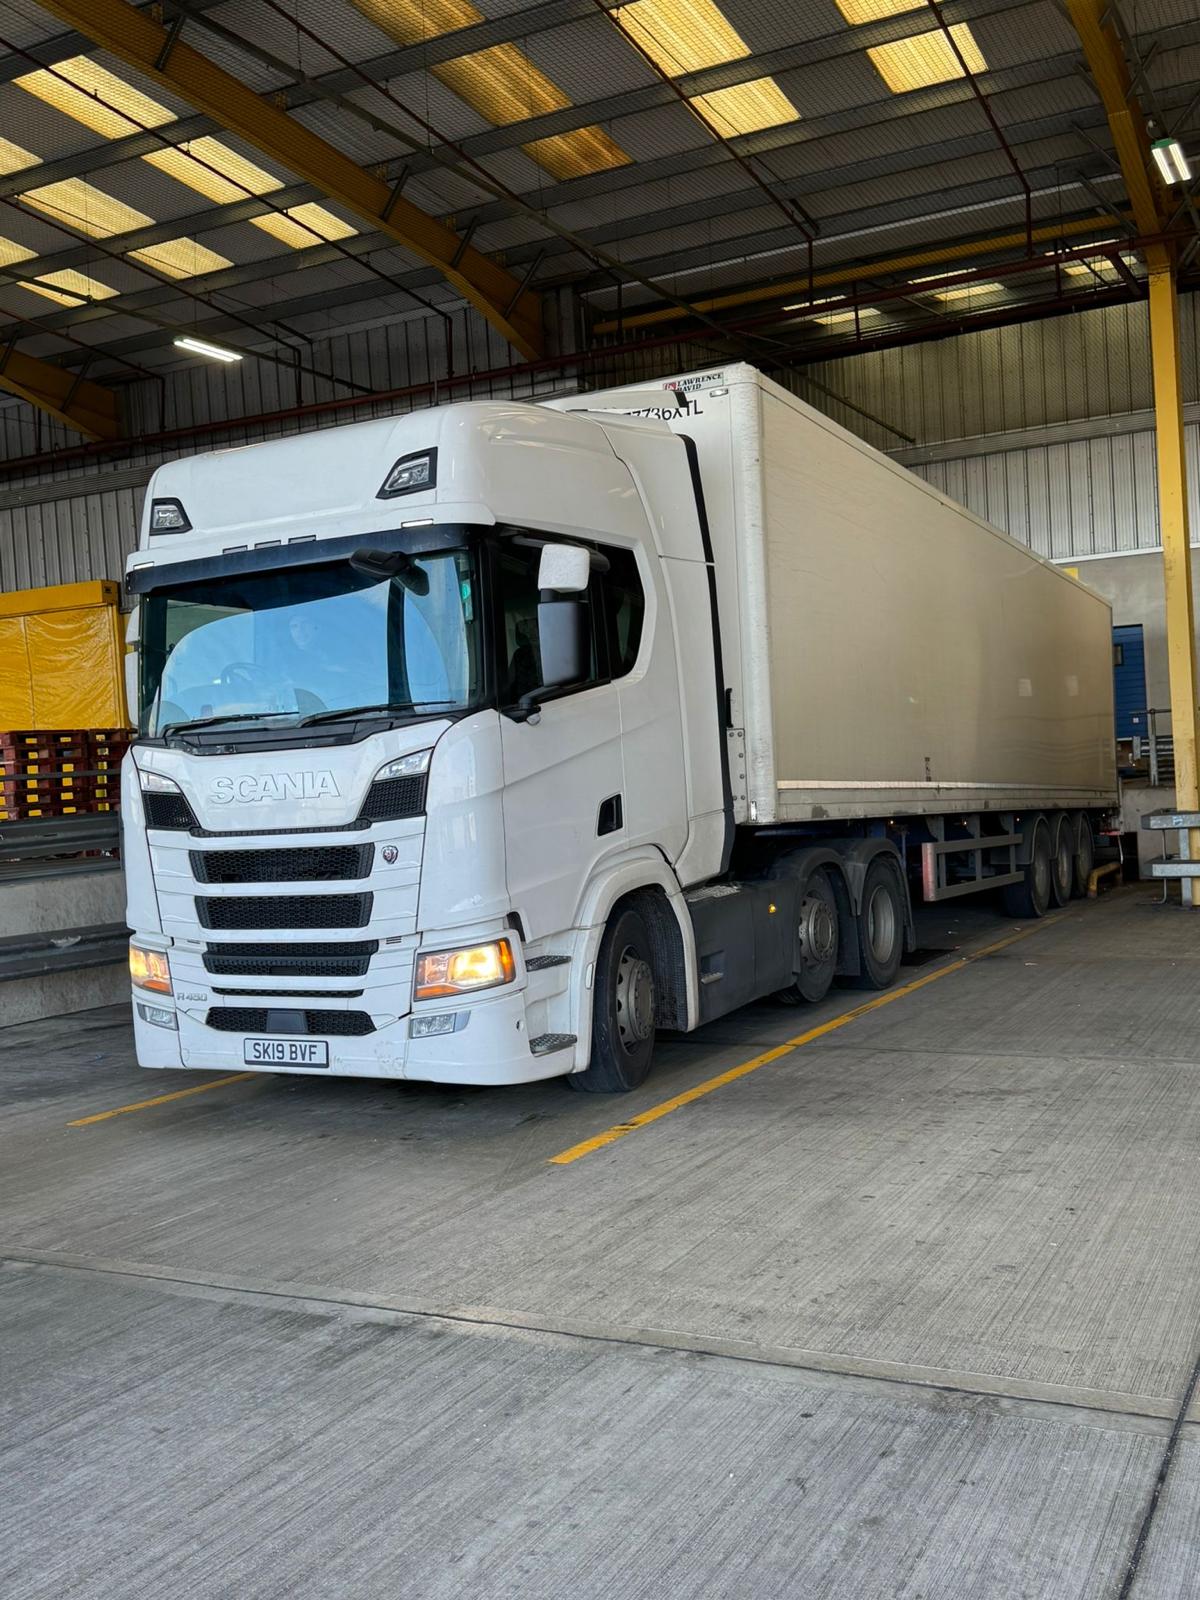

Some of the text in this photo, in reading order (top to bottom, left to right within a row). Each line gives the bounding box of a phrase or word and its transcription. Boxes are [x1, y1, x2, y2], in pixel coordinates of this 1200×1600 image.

[677, 374, 722, 386] LAWRENCE
[210, 770, 341, 804] SCANIA
[252, 1042, 318, 1062] SK19 BVF
